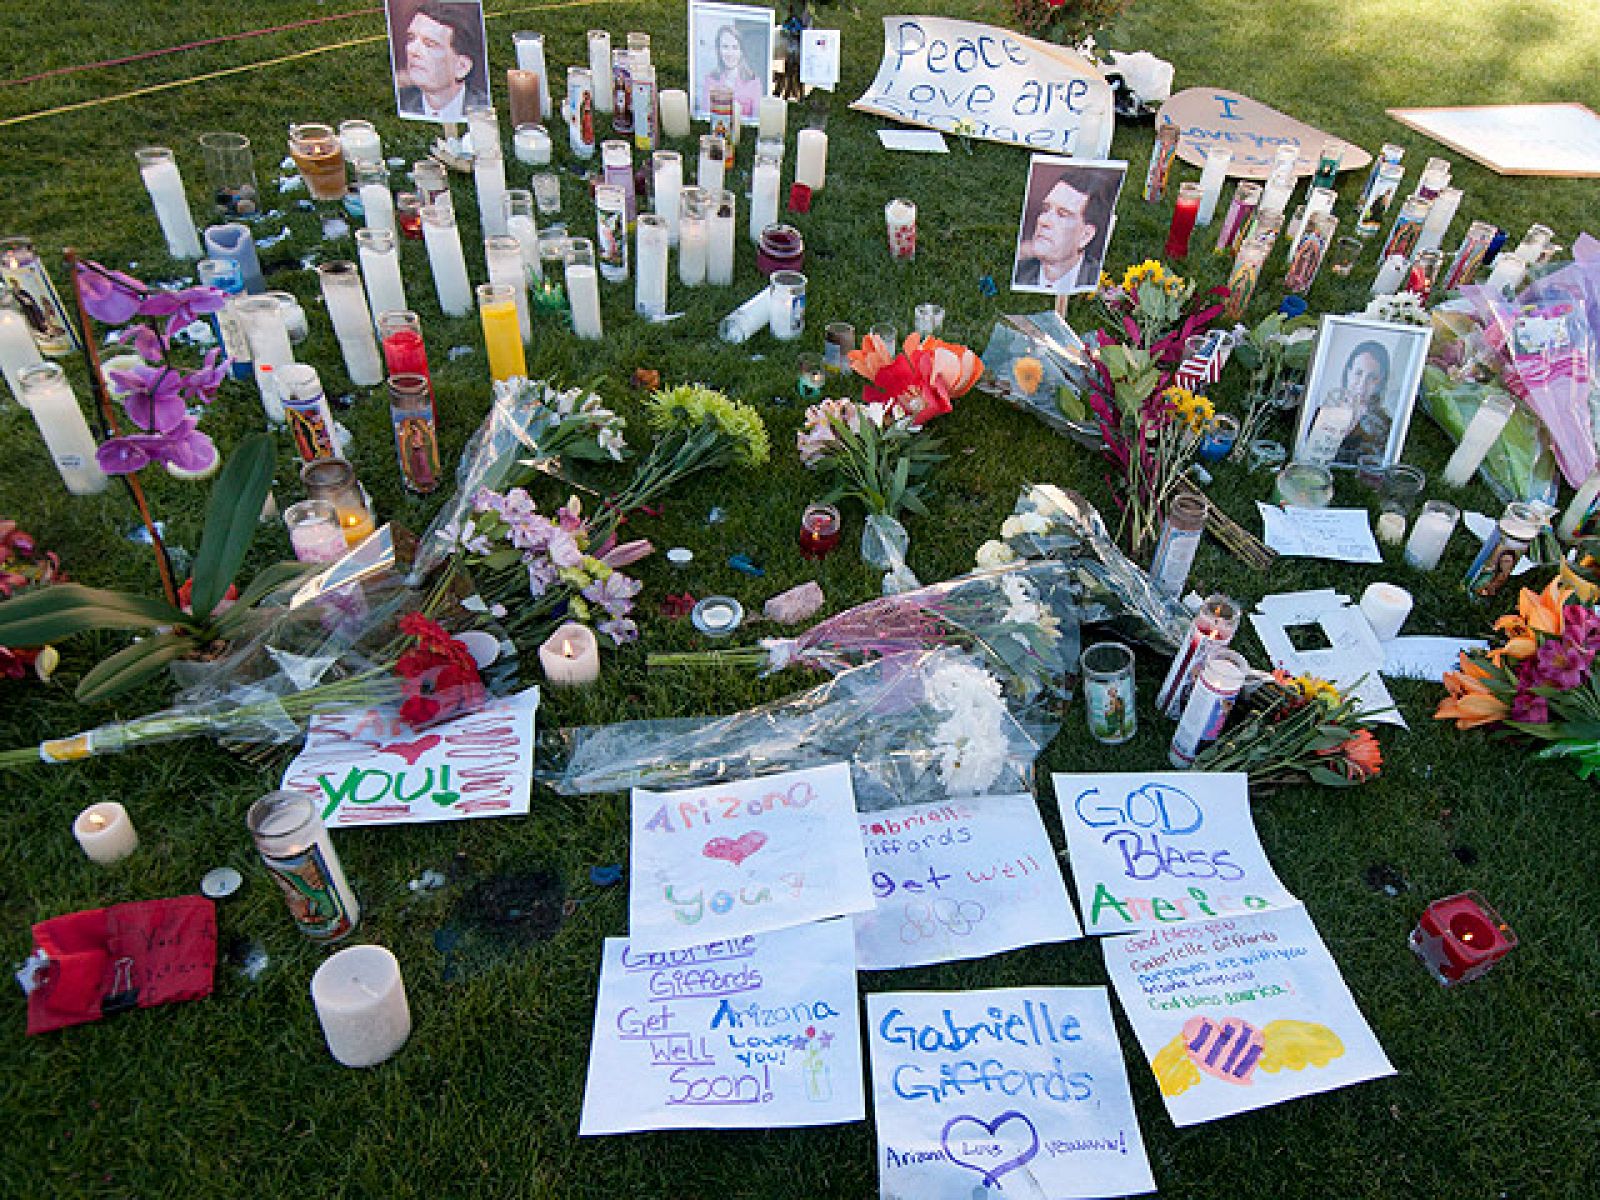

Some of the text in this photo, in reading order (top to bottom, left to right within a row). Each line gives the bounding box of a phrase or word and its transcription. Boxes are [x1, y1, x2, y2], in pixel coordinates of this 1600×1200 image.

[895, 21, 1029, 73] Peace
[874, 79, 1090, 116] Love are
[1214, 94, 1244, 120] I
[643, 781, 818, 834] Arizona
[1074, 781, 1204, 836] GOD
[871, 855, 1041, 898] get well
[1090, 882, 1269, 926] America
[649, 963, 764, 997] Giffords
[616, 1003, 676, 1038] Get
[709, 999, 841, 1030] Arizona
[879, 999, 1084, 1052] Gabrielle
[668, 1063, 775, 1104] Soon!
